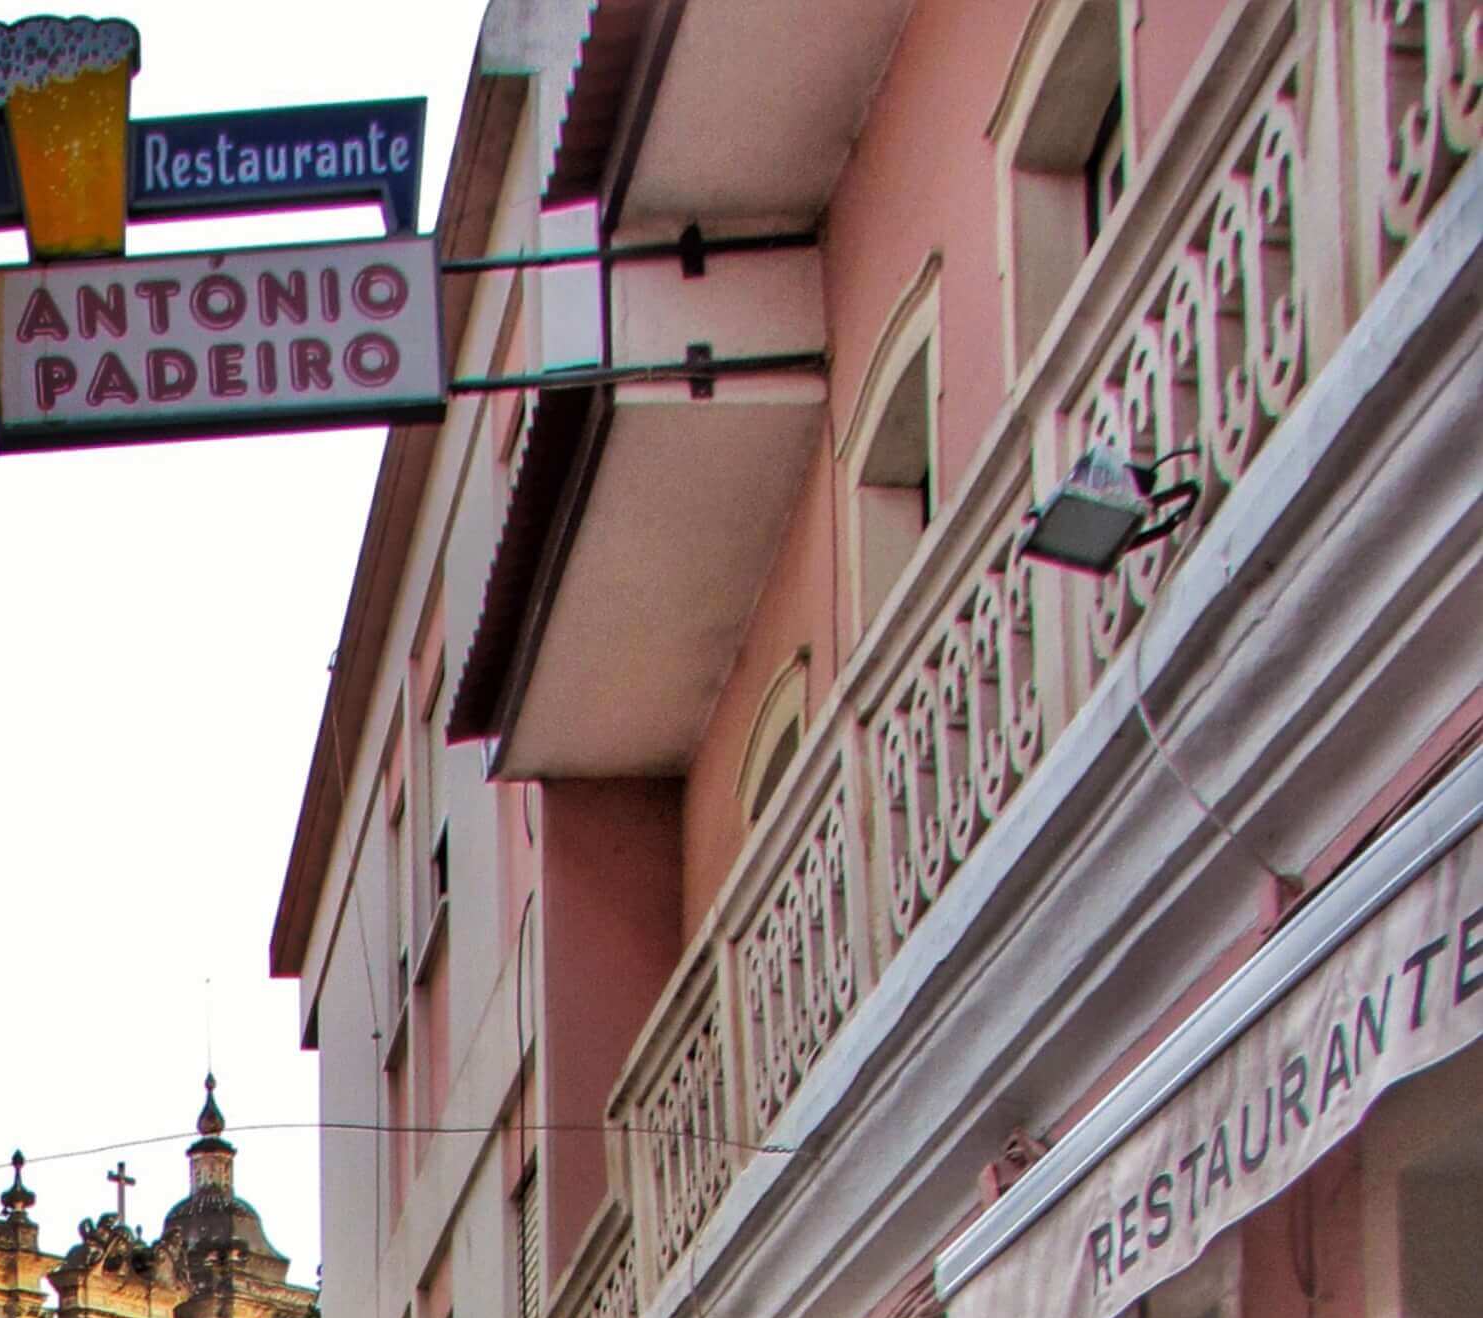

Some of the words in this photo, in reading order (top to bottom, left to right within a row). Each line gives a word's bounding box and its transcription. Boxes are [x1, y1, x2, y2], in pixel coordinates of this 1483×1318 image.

[143, 121, 412, 191] Restaurante
[17, 255, 410, 344] ANTÓNIO
[34, 332, 401, 413] PADEIRO
[1089, 908, 1483, 1296] RESTAURANTE
